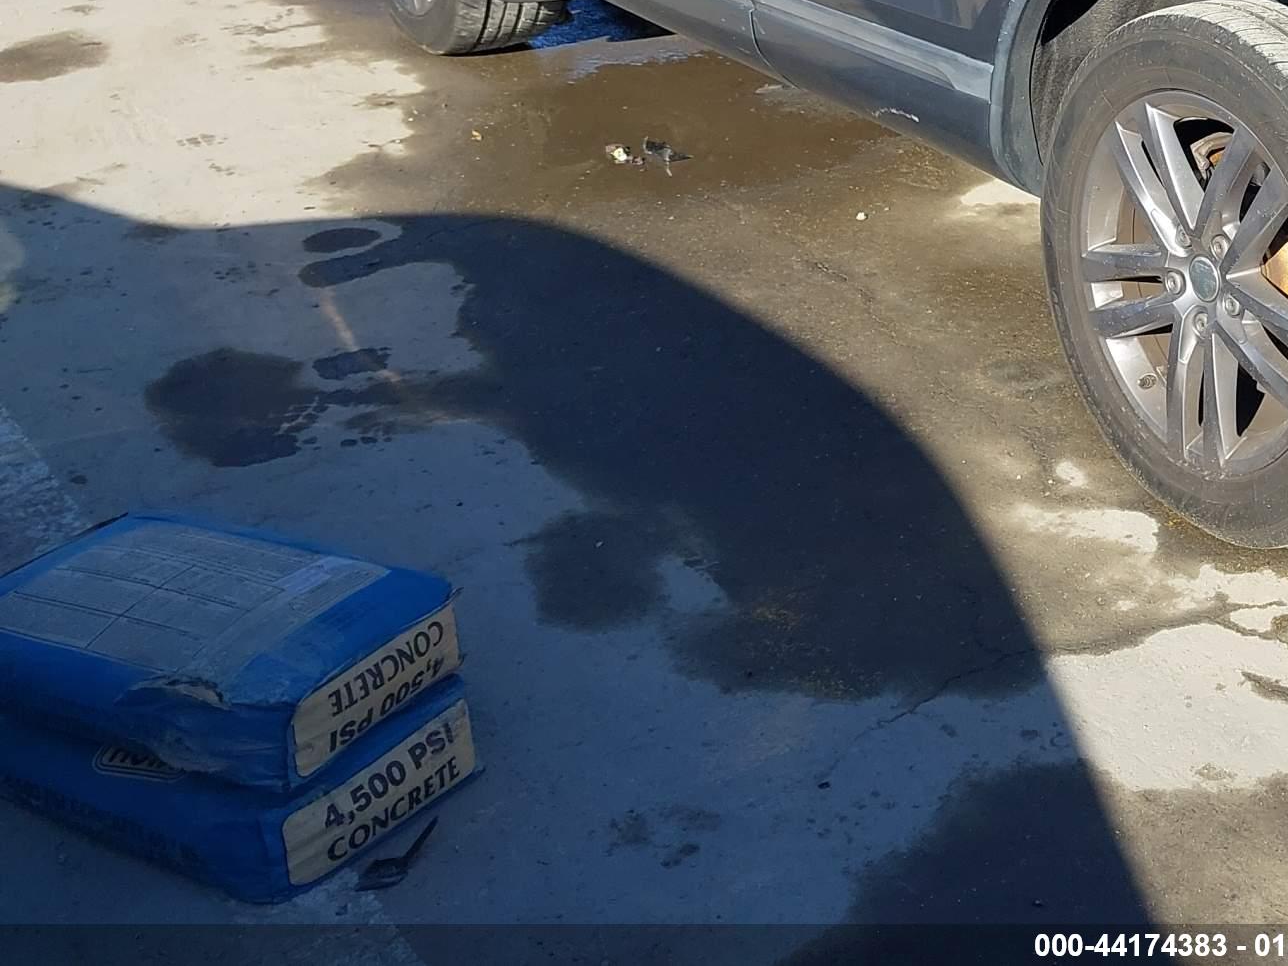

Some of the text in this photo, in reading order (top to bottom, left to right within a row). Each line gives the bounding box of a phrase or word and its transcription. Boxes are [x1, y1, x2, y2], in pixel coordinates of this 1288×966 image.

[328, 621, 444, 717] CONCRETE
[324, 722, 454, 829] 4,500 PSI
[327, 755, 460, 862] CONCRETE
